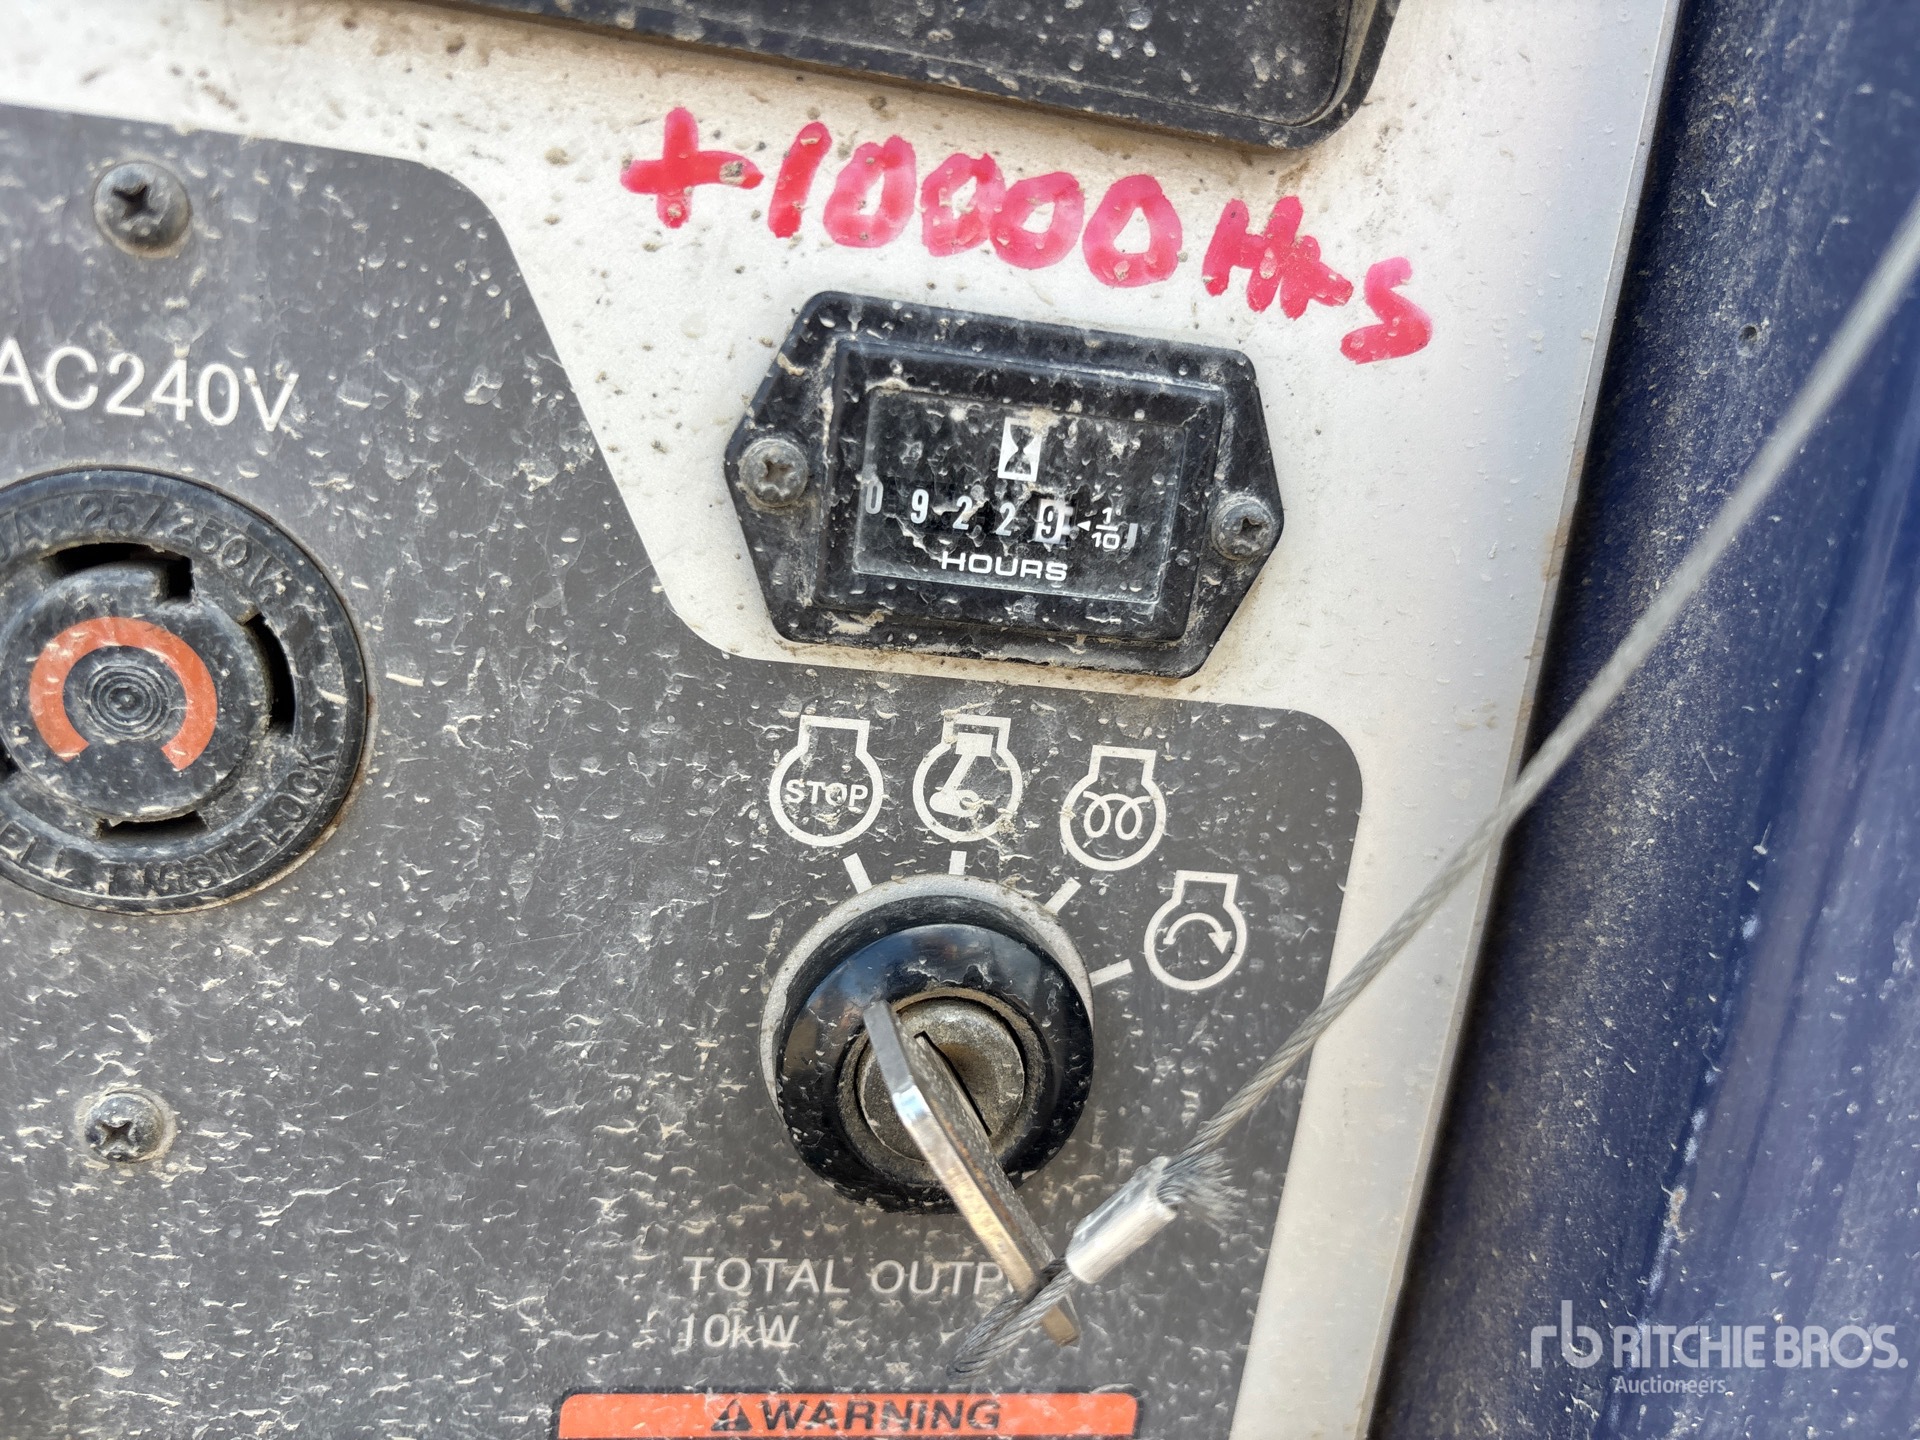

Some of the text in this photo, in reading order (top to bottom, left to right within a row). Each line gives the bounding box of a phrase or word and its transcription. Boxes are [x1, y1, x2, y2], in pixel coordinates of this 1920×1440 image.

[0, 337, 299, 432] AC240V
[941, 551, 1068, 581] HOURS
[785, 779, 869, 806] STOP
[683, 1255, 1014, 1294] TOTAL OUTP
[680, 1313, 799, 1348] 10kW
[762, 1399, 1001, 1433] WARNING
